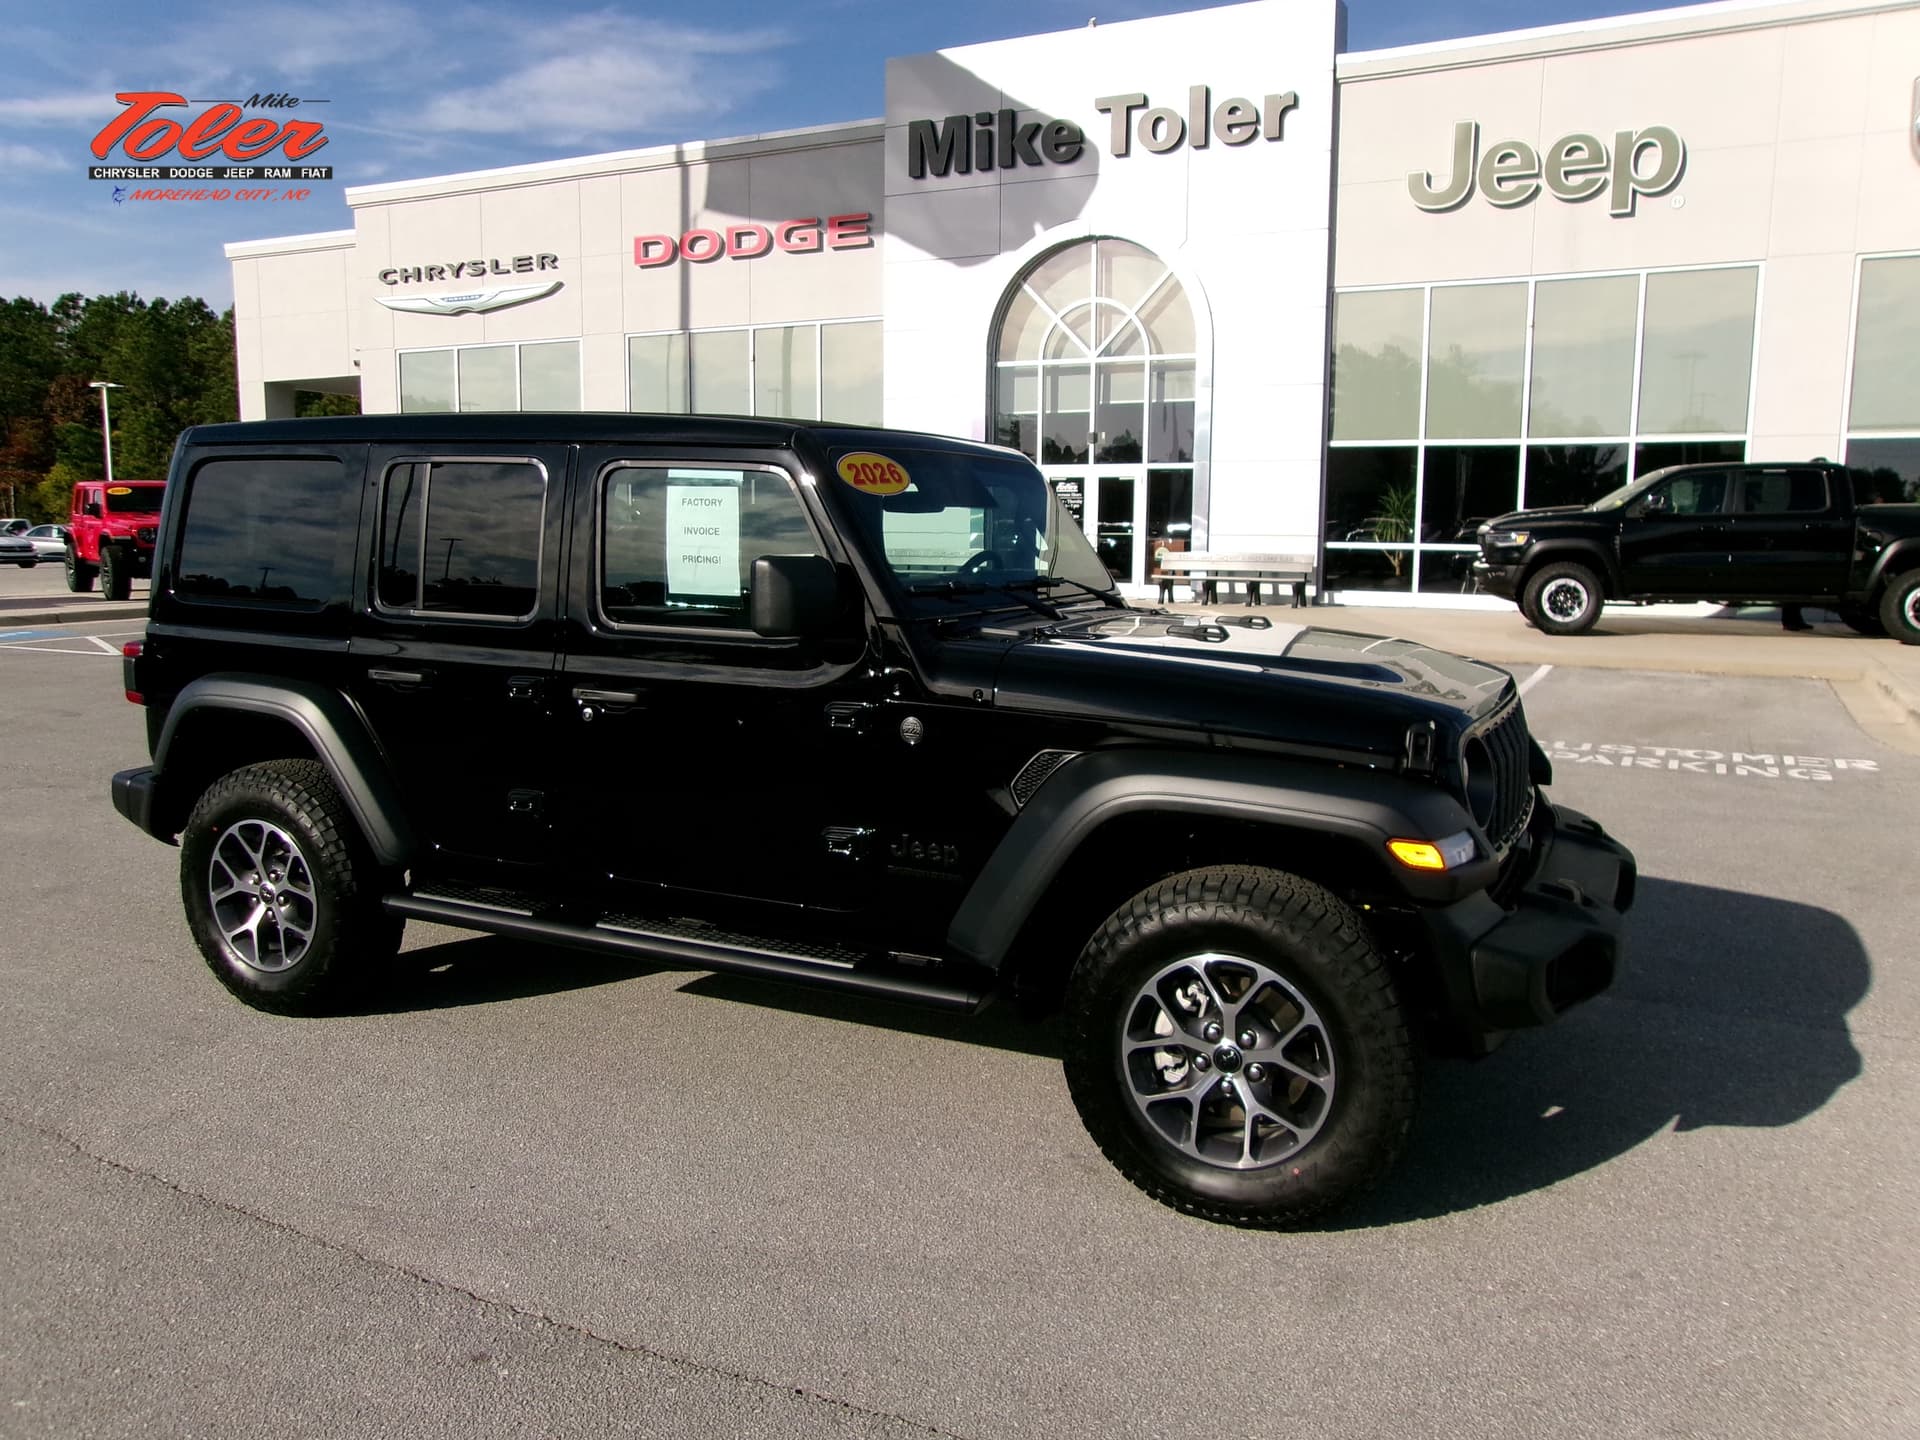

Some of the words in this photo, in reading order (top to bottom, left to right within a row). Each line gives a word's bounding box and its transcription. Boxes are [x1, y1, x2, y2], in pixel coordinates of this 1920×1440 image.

[908, 108, 1086, 179] Mike
[1095, 84, 1299, 157] Toler
[1406, 120, 1689, 218] Jeep
[634, 212, 874, 270] DODGE
[378, 252, 559, 285] CHRYSLER
[847, 462, 904, 487] 2026
[681, 497, 723, 508] FACTORY
[683, 526, 720, 536] INVOICE
[682, 554, 722, 565] PRICING!
[1535, 740, 1880, 771] USTOMER
[887, 832, 960, 862] Jeep
